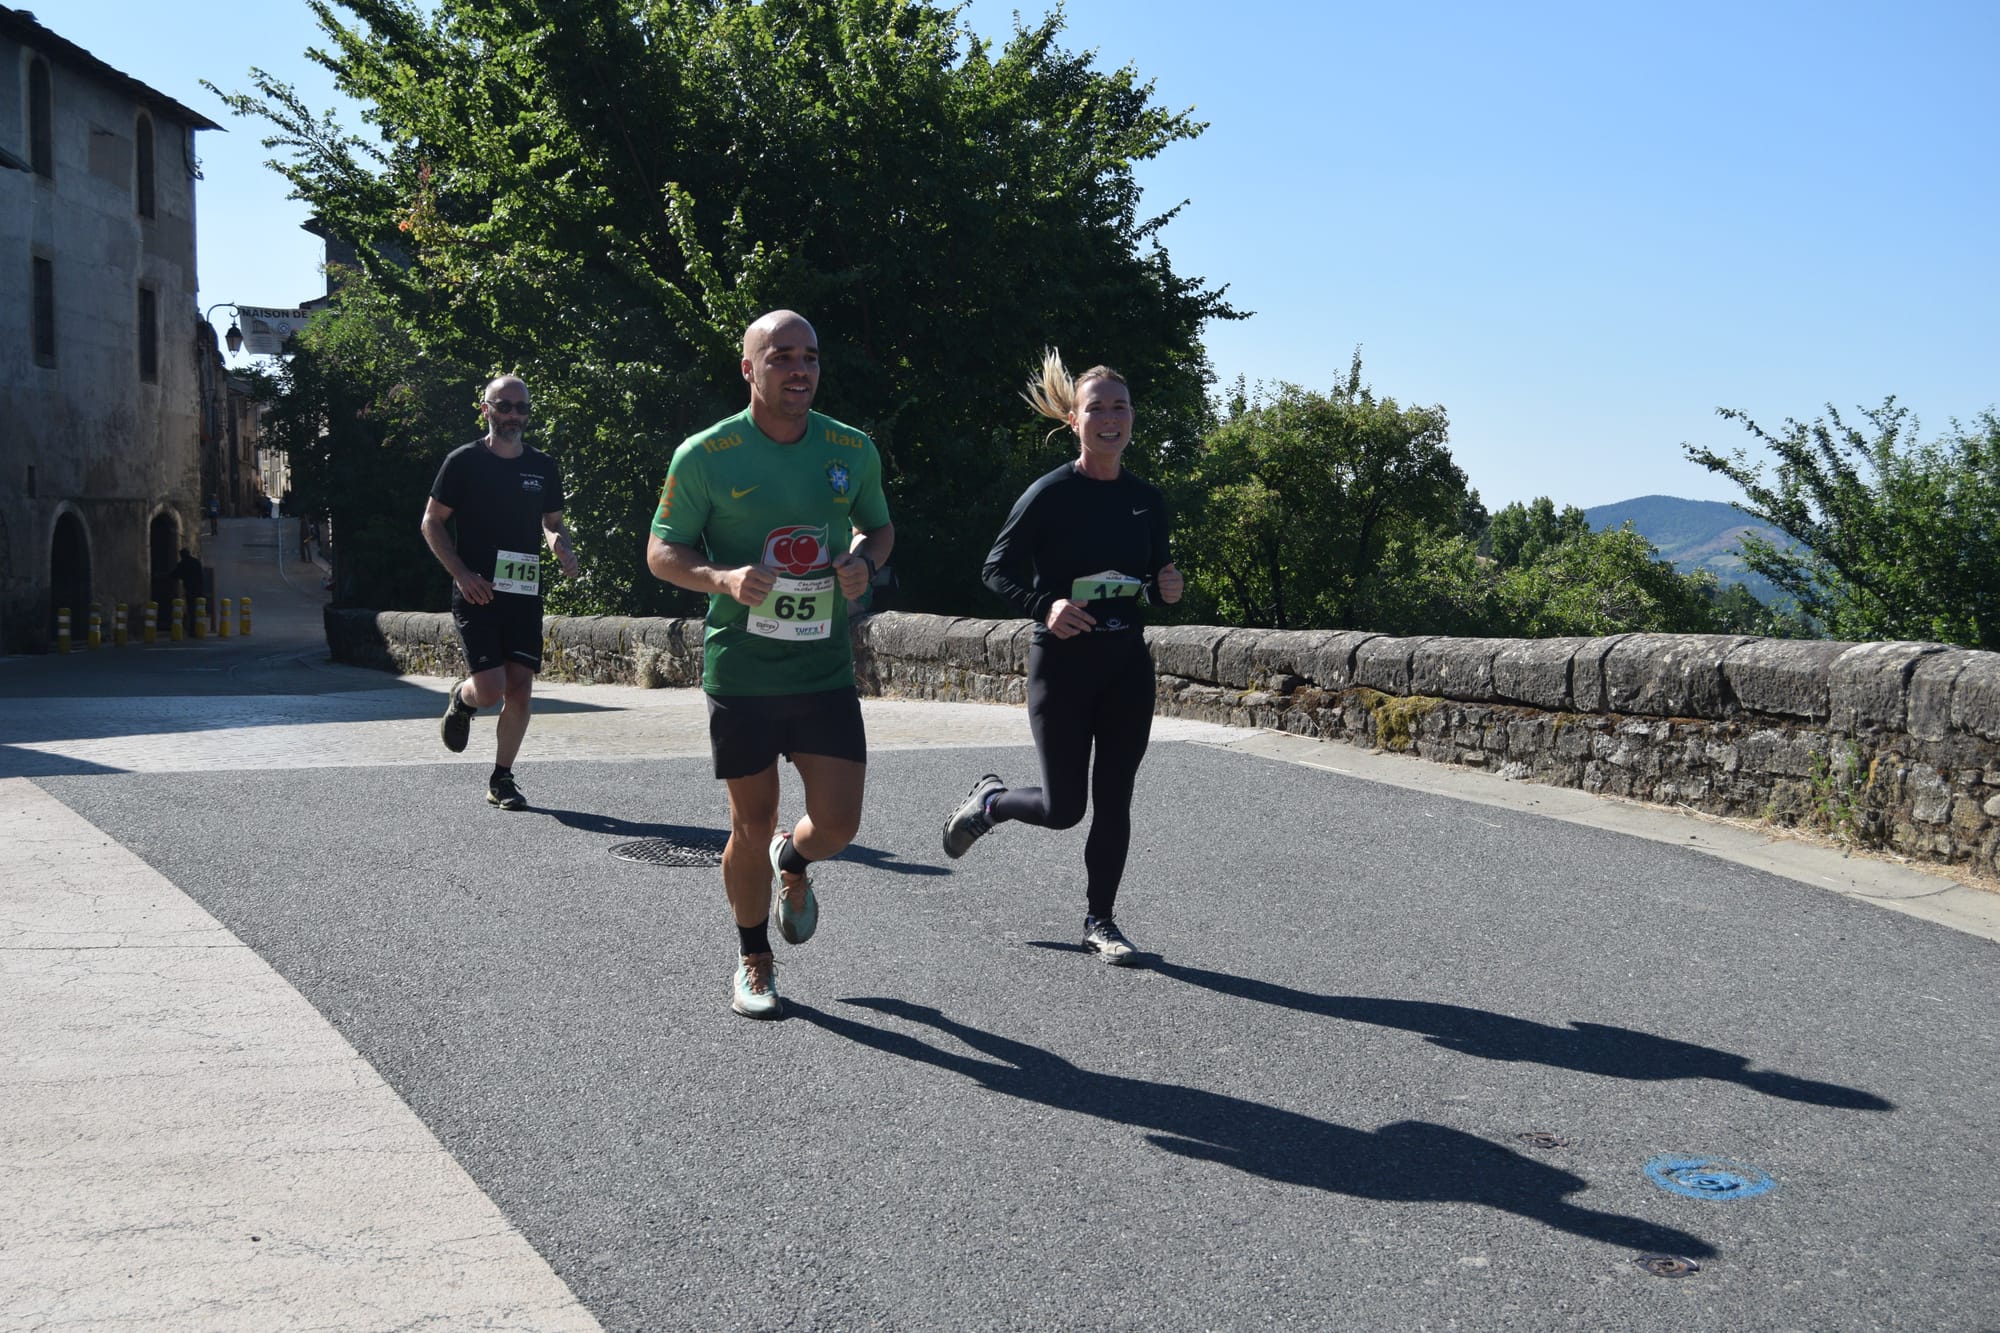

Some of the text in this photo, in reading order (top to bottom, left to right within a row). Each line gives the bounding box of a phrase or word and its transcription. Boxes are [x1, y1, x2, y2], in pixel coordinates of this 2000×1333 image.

[242, 308, 289, 318] MAISON
[293, 309, 308, 318] DE
[701, 432, 743, 455] Itaú
[504, 562, 536, 581] 115
[774, 595, 816, 620] 65
